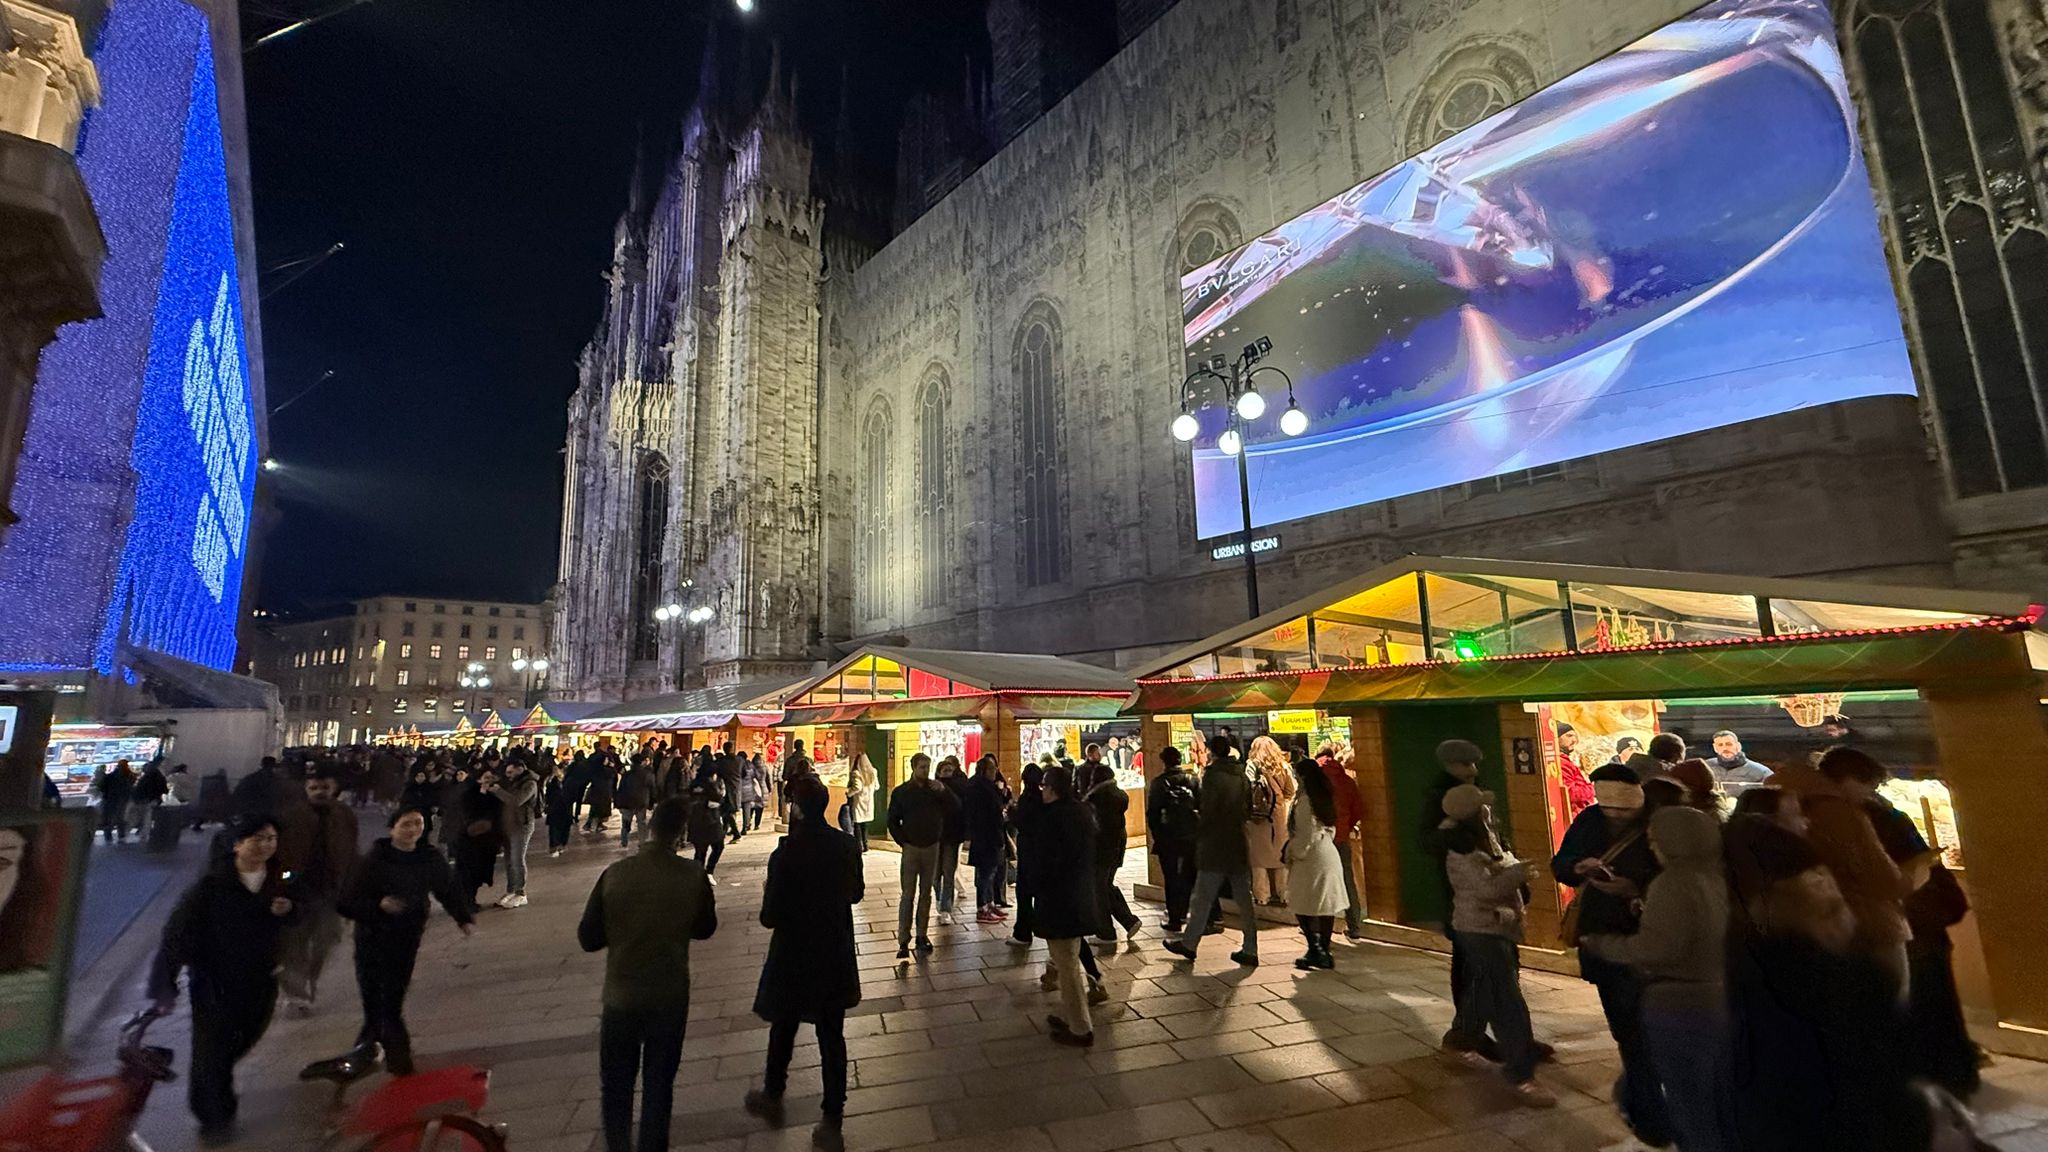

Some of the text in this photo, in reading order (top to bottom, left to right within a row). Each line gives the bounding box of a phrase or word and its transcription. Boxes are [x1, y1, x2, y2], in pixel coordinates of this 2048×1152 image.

[1198, 237, 1301, 298] BVLGARI
[1213, 537, 1278, 559] URBAN ISION
